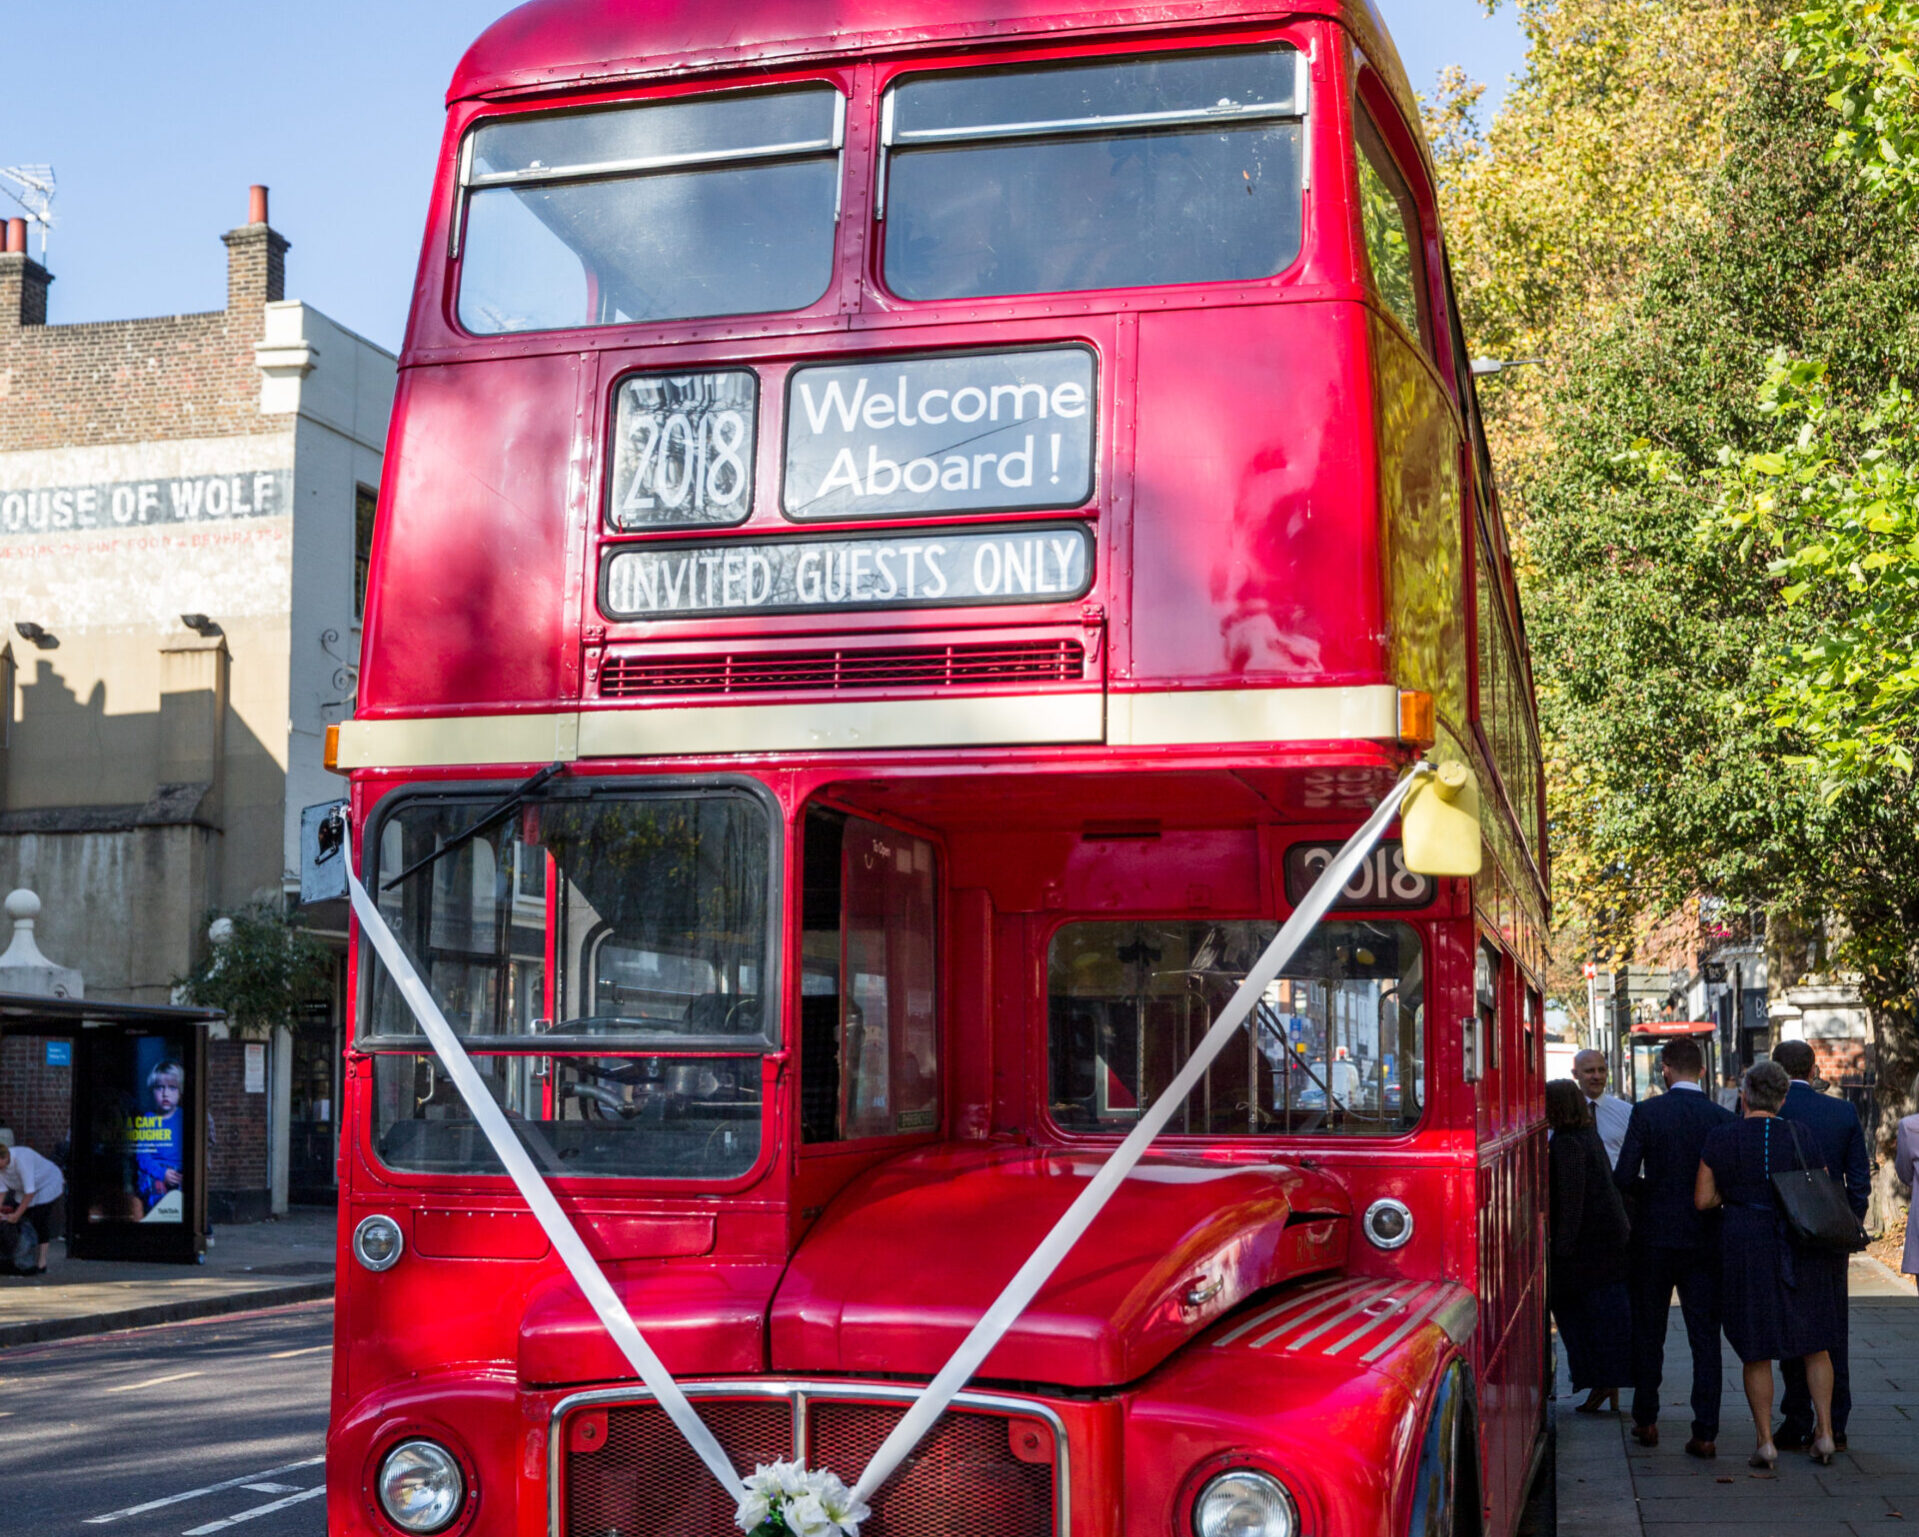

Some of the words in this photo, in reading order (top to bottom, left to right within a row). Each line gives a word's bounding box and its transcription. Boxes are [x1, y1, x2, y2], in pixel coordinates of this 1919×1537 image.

[799, 376, 1086, 435] Welcome
[622, 408, 746, 509] 2018
[111, 483, 159, 523] OF
[170, 474, 275, 519] WOLF
[621, 554, 771, 610] INVITED
[795, 544, 946, 603] GUESTS
[974, 536, 1077, 596] ONLY
